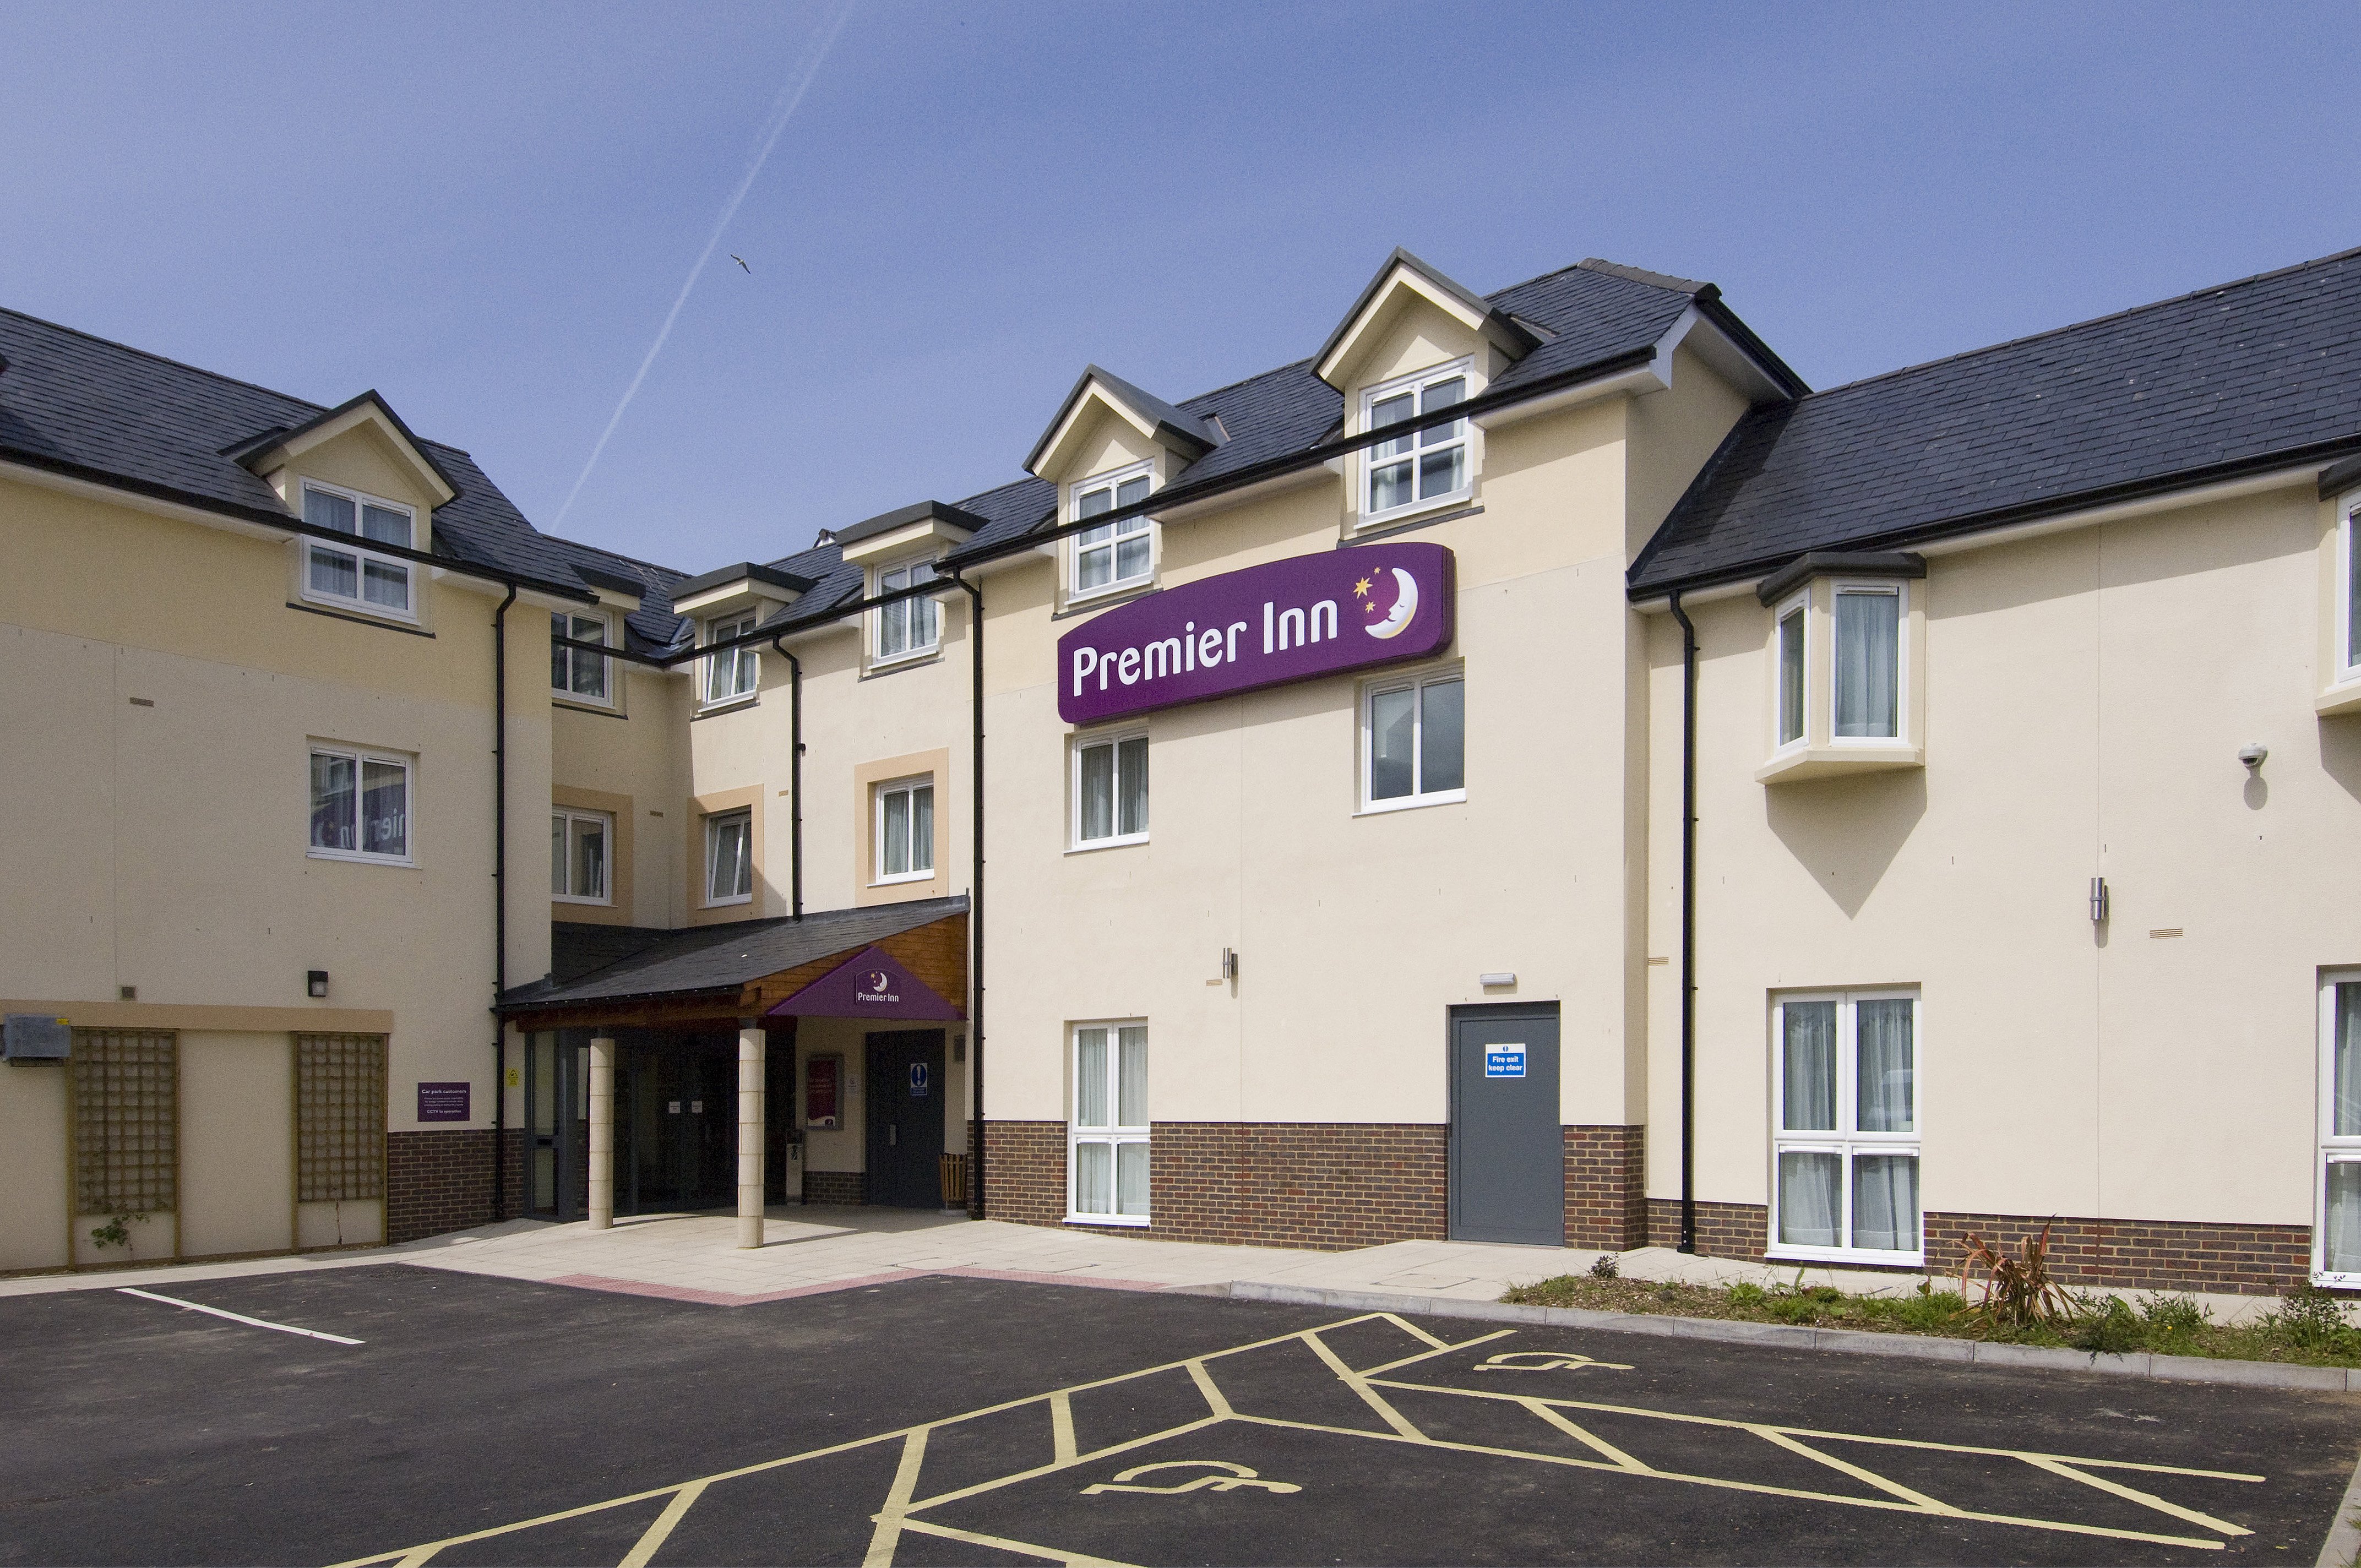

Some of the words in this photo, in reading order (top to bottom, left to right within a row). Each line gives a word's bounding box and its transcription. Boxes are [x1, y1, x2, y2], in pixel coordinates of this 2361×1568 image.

[1073, 621, 1247, 697] Premier
[1264, 599, 1338, 654] Inn
[858, 992, 887, 1002] Premier
[888, 993, 899, 1002] Inn
[1488, 1064, 1505, 1072] keep
